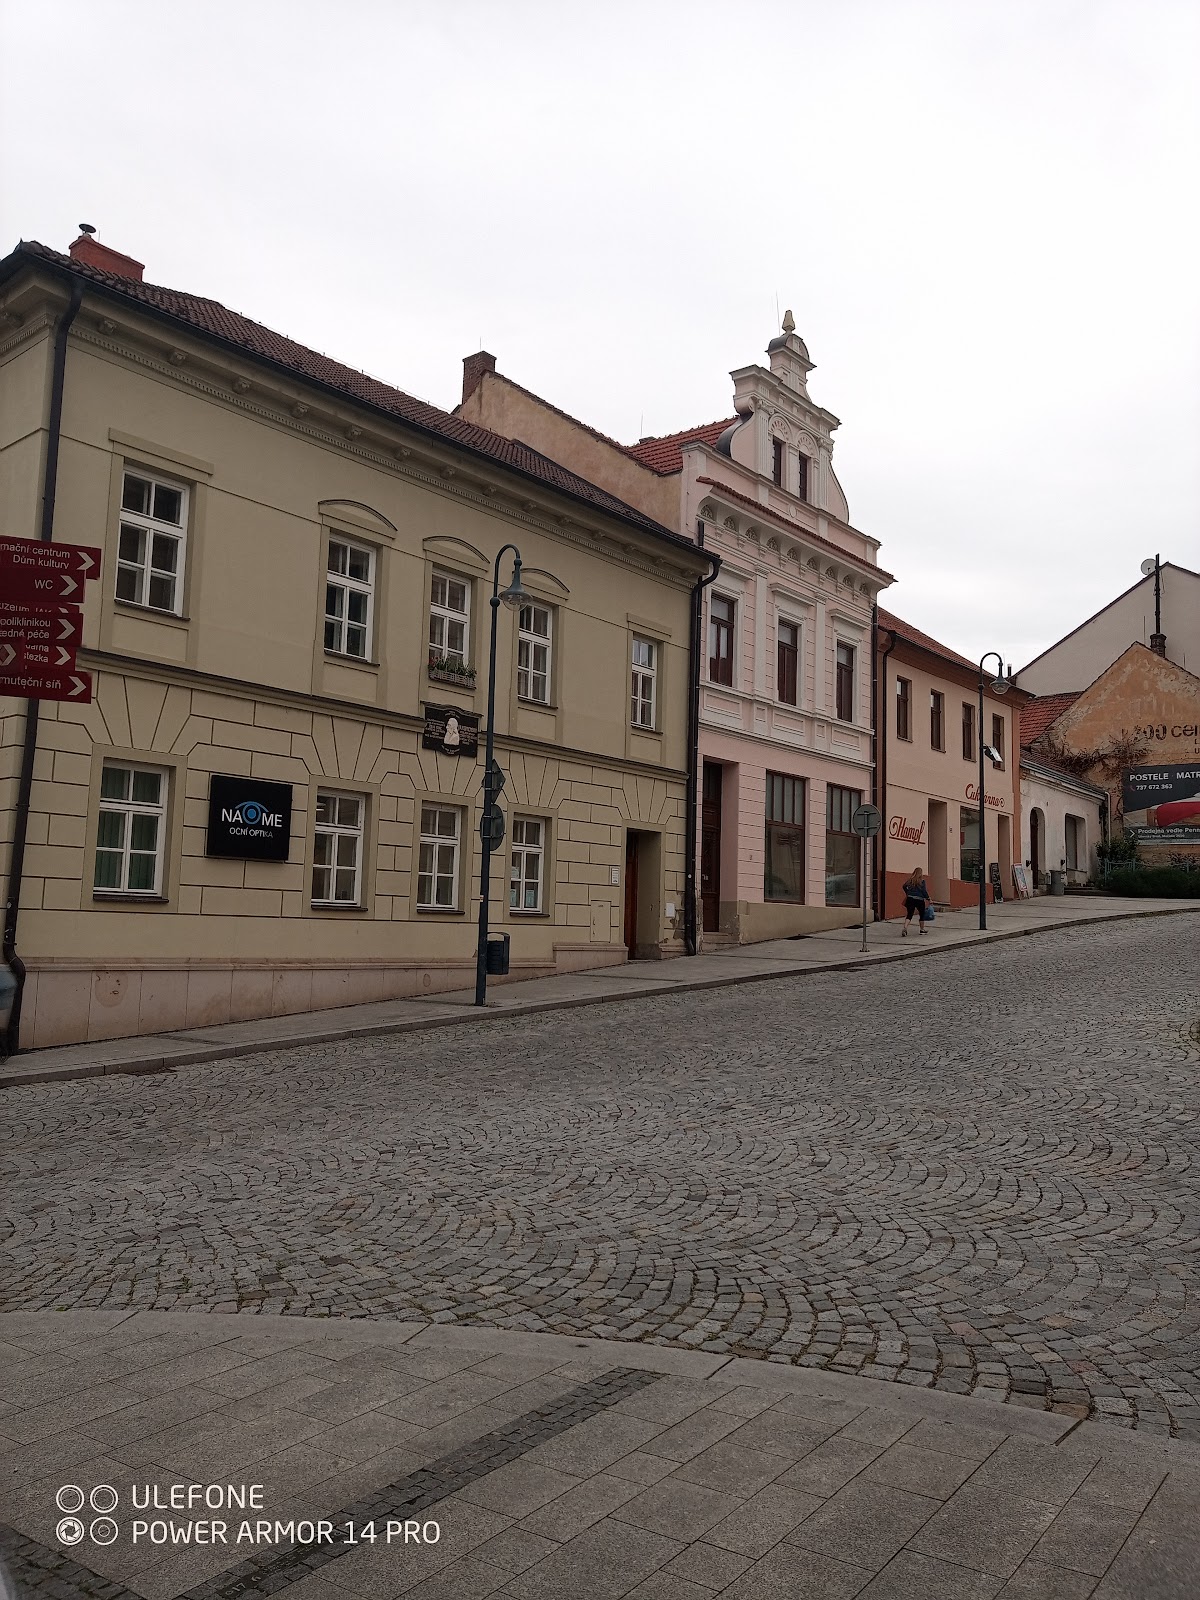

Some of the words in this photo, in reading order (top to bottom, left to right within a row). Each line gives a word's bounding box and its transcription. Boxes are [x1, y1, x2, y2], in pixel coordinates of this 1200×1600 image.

[32, 547, 71, 559] centrum
[13, 554, 36, 566] Dům
[34, 579, 54, 590] WC
[27, 629, 50, 640] péče
[45, 679, 61, 690] síň
[1129, 773, 1169, 781] POSTELE
[249, 829, 273, 839] OPTIKA
